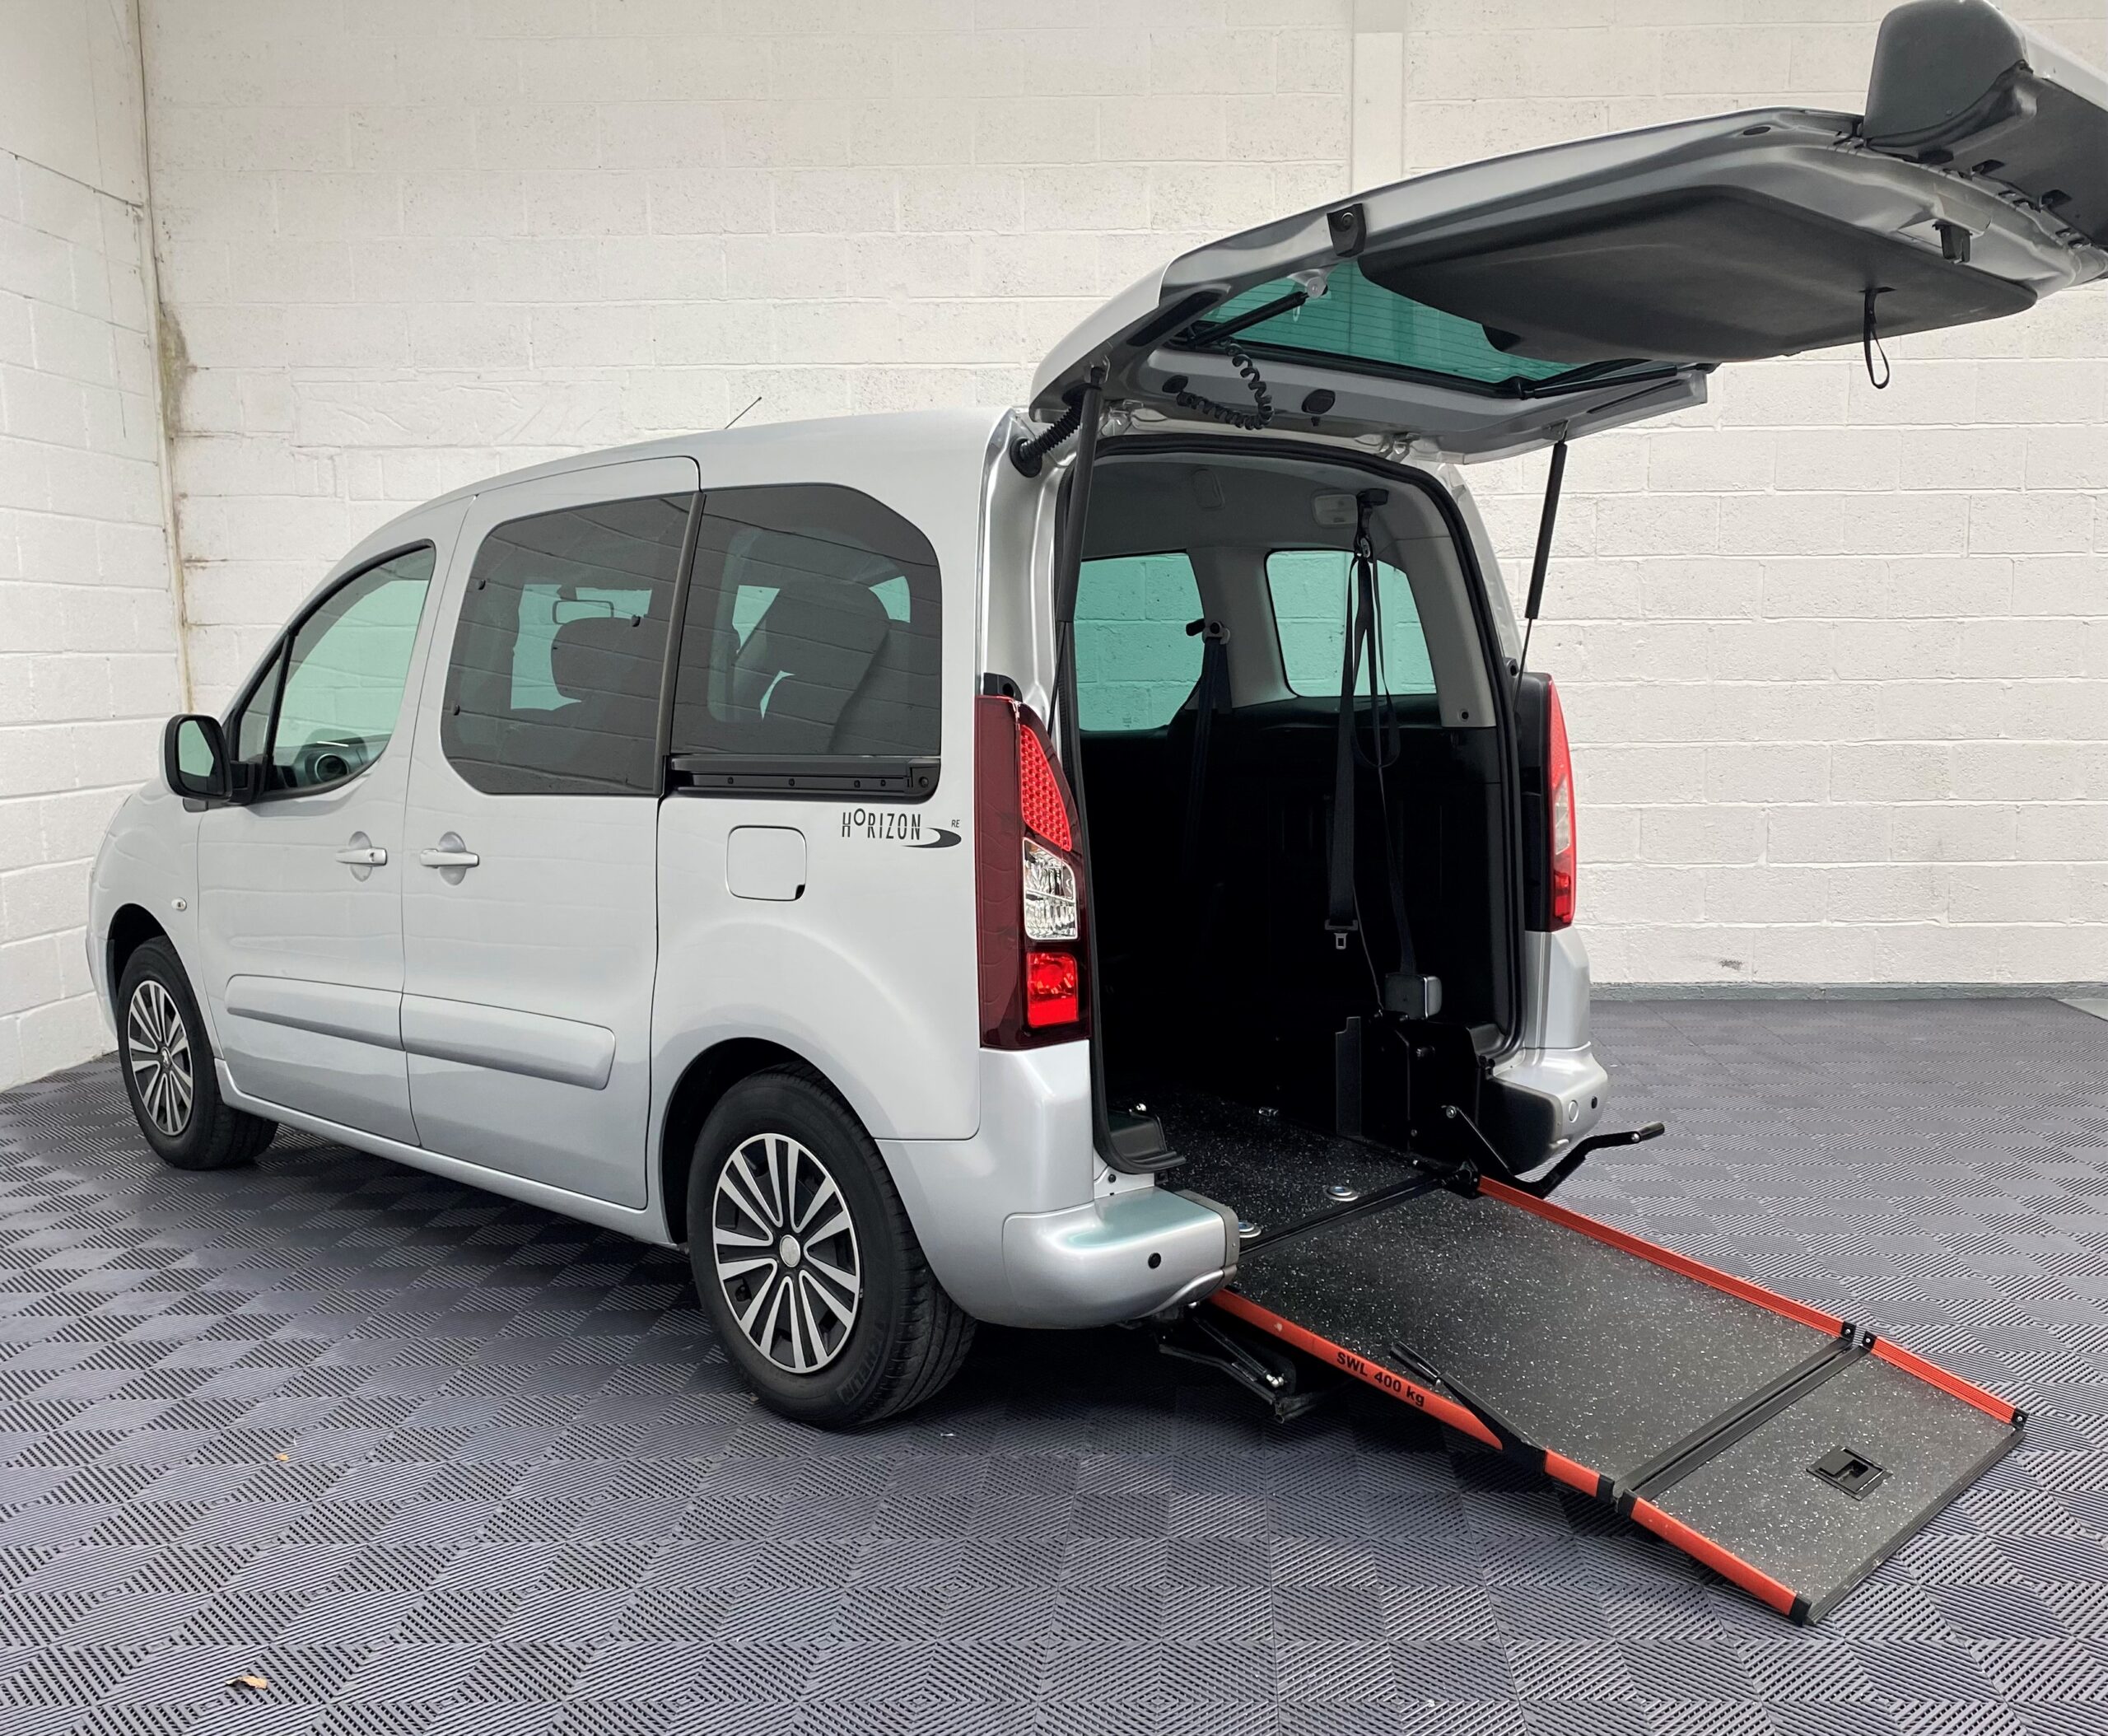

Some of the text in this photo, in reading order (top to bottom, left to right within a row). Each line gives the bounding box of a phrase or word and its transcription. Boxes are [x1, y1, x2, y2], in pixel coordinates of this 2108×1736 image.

[842, 808, 960, 840] HORIZON RE
[1336, 1351, 1425, 1407] SWL 400 kg
